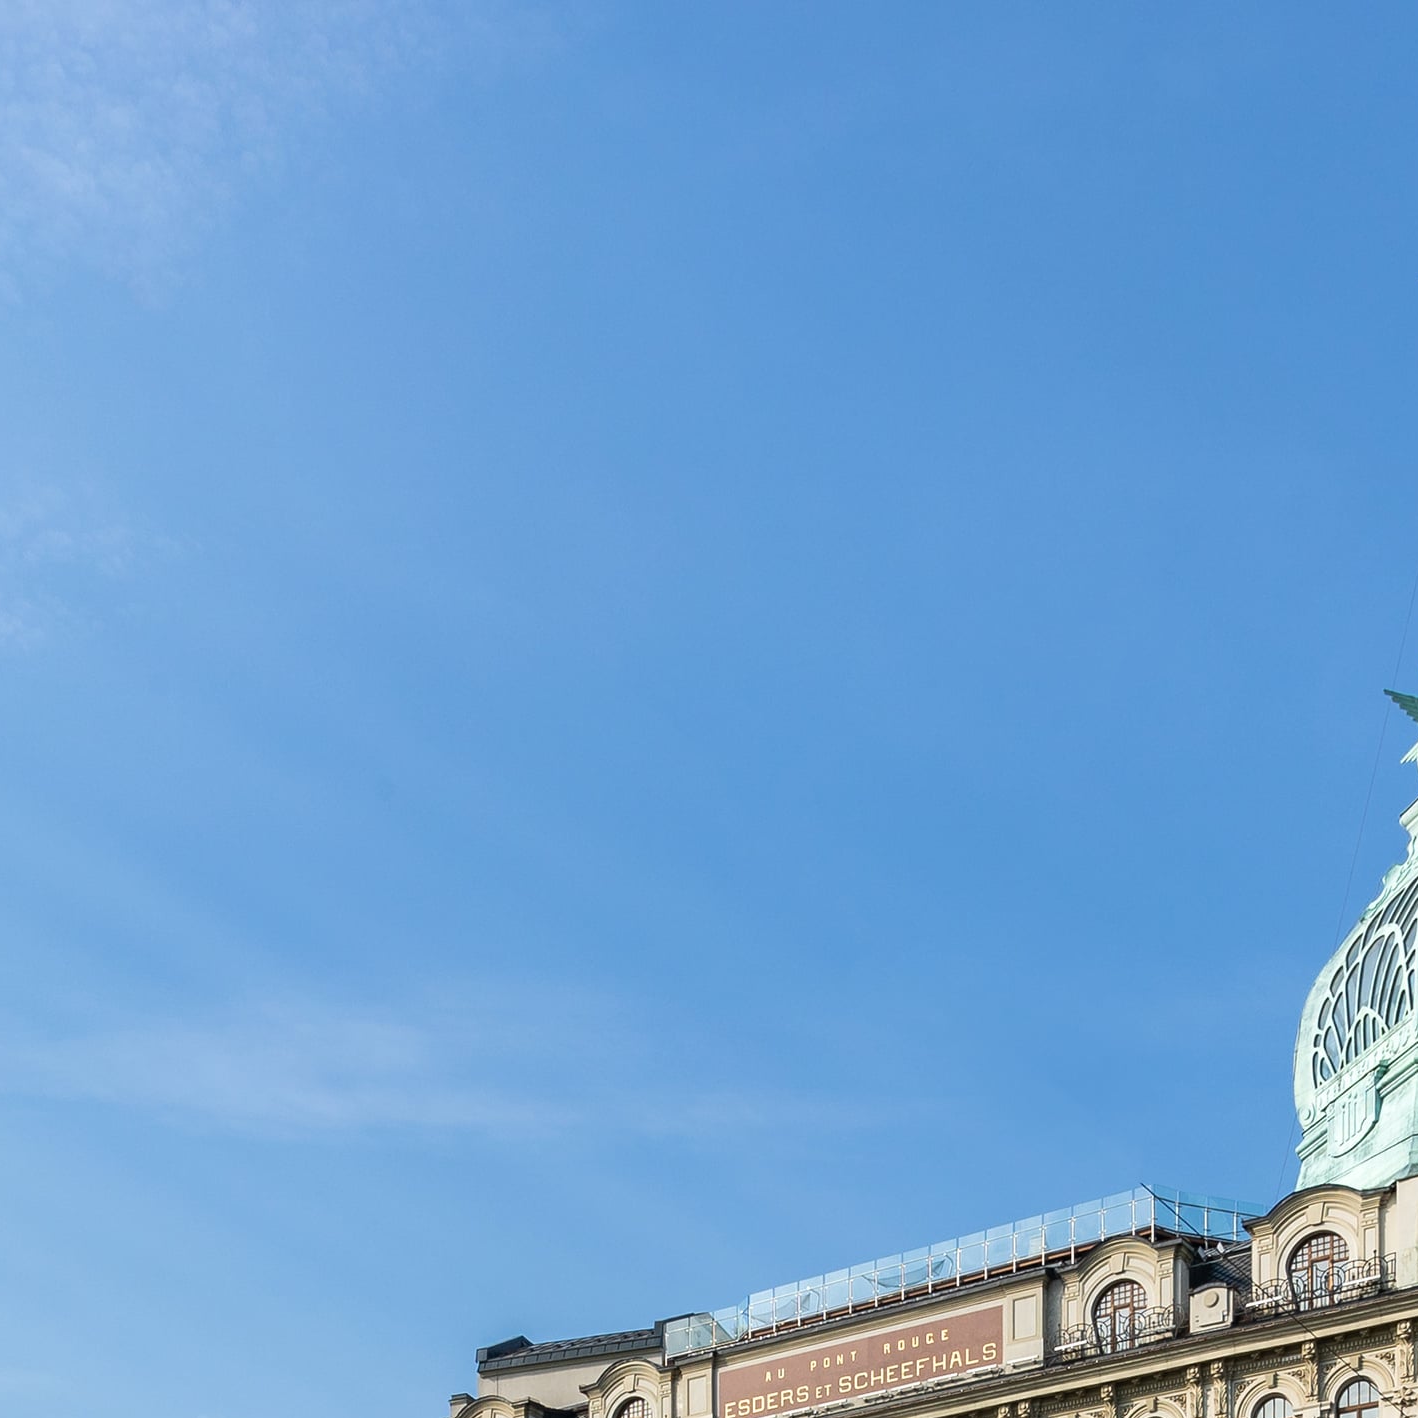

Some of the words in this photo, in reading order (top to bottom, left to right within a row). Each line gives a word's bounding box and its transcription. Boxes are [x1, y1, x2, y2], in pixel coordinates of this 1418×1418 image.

[765, 1368, 785, 1382] AU
[810, 1351, 857, 1371] PONT
[884, 1329, 950, 1354] ROUGE
[816, 1383, 832, 1399] ET
[838, 1342, 998, 1394] SCHEEFHALS
